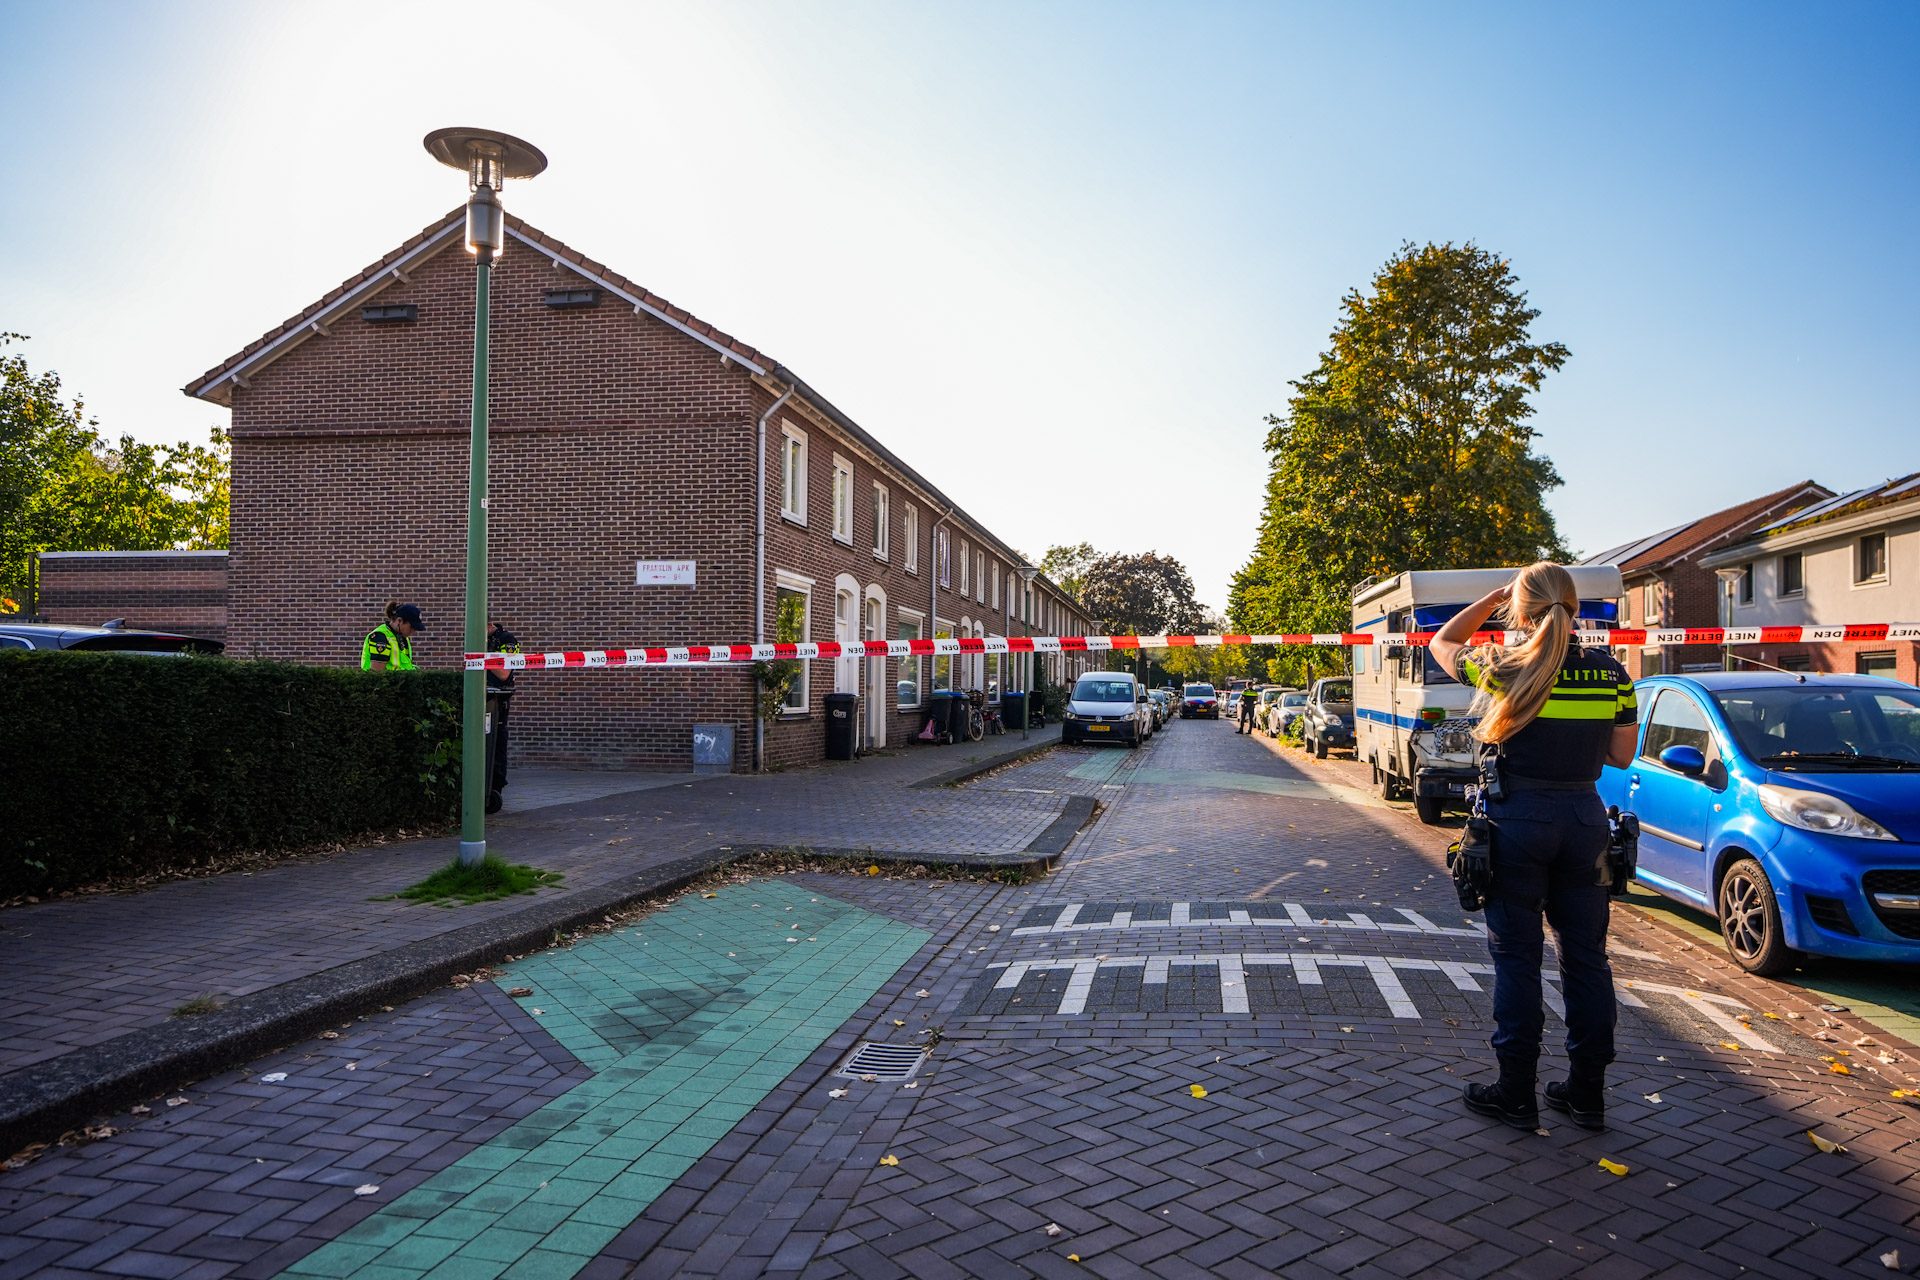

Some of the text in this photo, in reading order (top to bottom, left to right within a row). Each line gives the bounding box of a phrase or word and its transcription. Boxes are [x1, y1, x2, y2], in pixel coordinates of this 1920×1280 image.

[1657, 632, 1756, 642] NIET BETREDEN
[1813, 628, 1920, 639] NIET BETREDEN
[1578, 635, 1605, 643] NIET
[847, 646, 889, 654] BETREDEN
[890, 645, 908, 653] NIET
[942, 643, 985, 651] BETREDEN
[673, 652, 711, 660] BETREDEN
[712, 651, 729, 659] NIET
[798, 648, 816, 656] NIET
[466, 660, 483, 668] NIET
[510, 658, 546, 666] BETREDEN
[1562, 669, 1609, 681] LITIE
